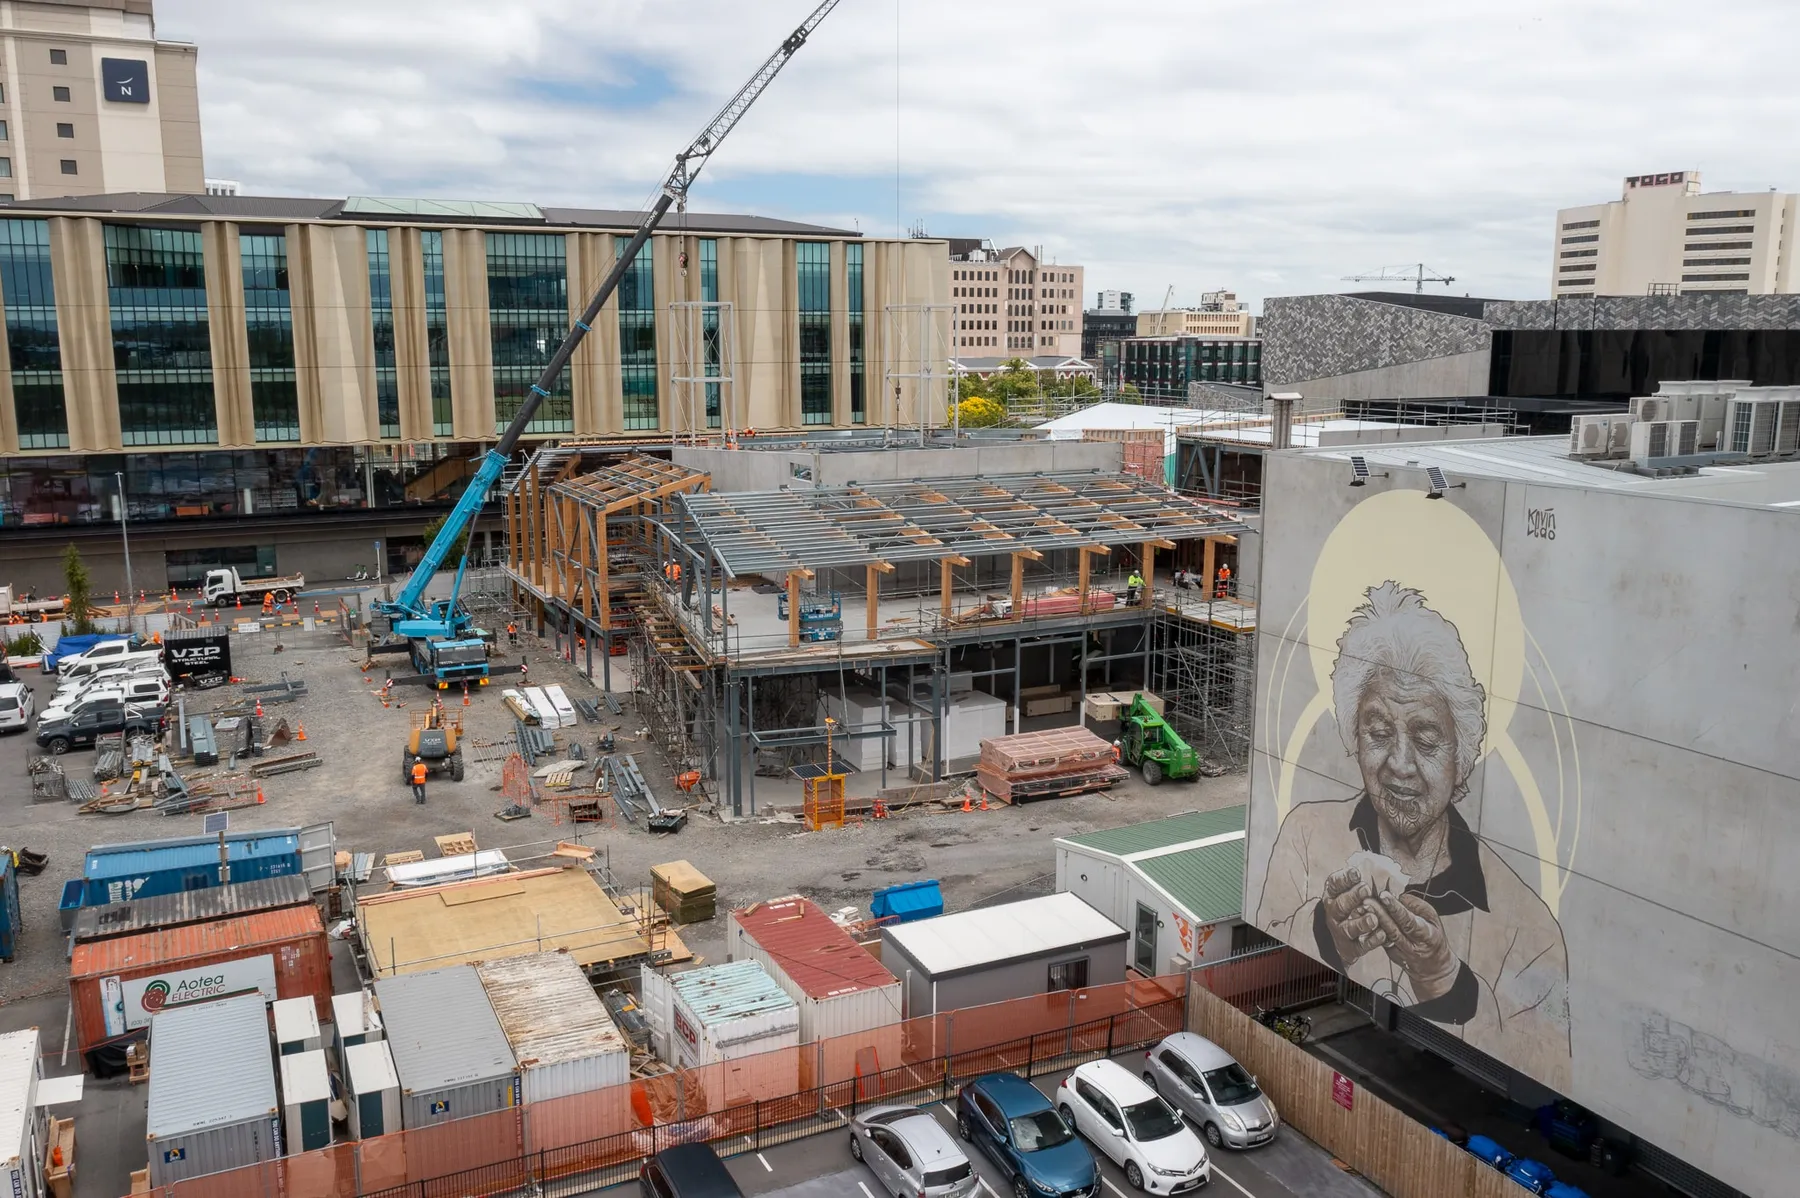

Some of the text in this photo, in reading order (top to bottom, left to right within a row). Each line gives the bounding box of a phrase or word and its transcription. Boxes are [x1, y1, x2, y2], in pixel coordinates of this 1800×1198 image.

[121, 86, 132, 96] N
[1626, 171, 1684, 188] TOGO
[171, 646, 221, 658] VIP
[199, 676, 223, 684] VIP
[176, 975, 225, 992] Aotea
[171, 984, 226, 1002] ELECTRIC
[675, 1010, 697, 1045] BCP
